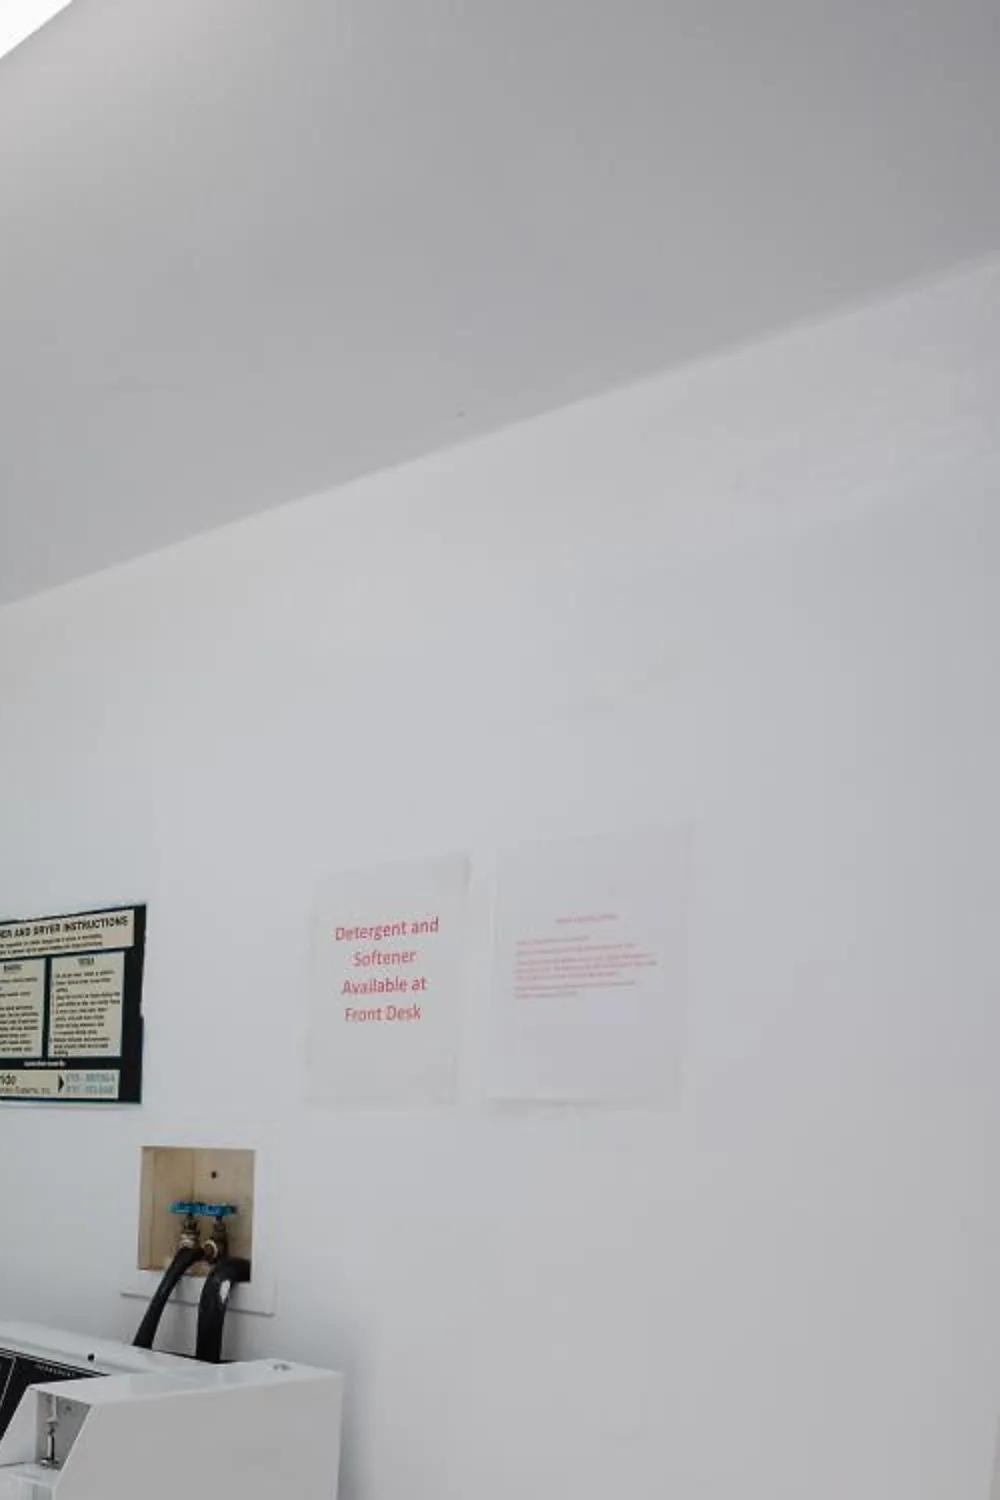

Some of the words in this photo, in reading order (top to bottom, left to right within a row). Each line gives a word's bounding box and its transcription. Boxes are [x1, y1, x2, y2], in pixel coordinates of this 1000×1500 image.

[14, 926, 30, 938] AND
[34, 924, 61, 935] DRYER
[64, 915, 128, 932] INSTRUCTIONS
[335, 920, 406, 941] Detergent
[411, 916, 439, 933] and
[353, 950, 417, 967] Softener
[341, 976, 408, 995] Available
[411, 976, 428, 991] at
[344, 1007, 382, 1022] Front
[386, 1003, 421, 1021] Desk
